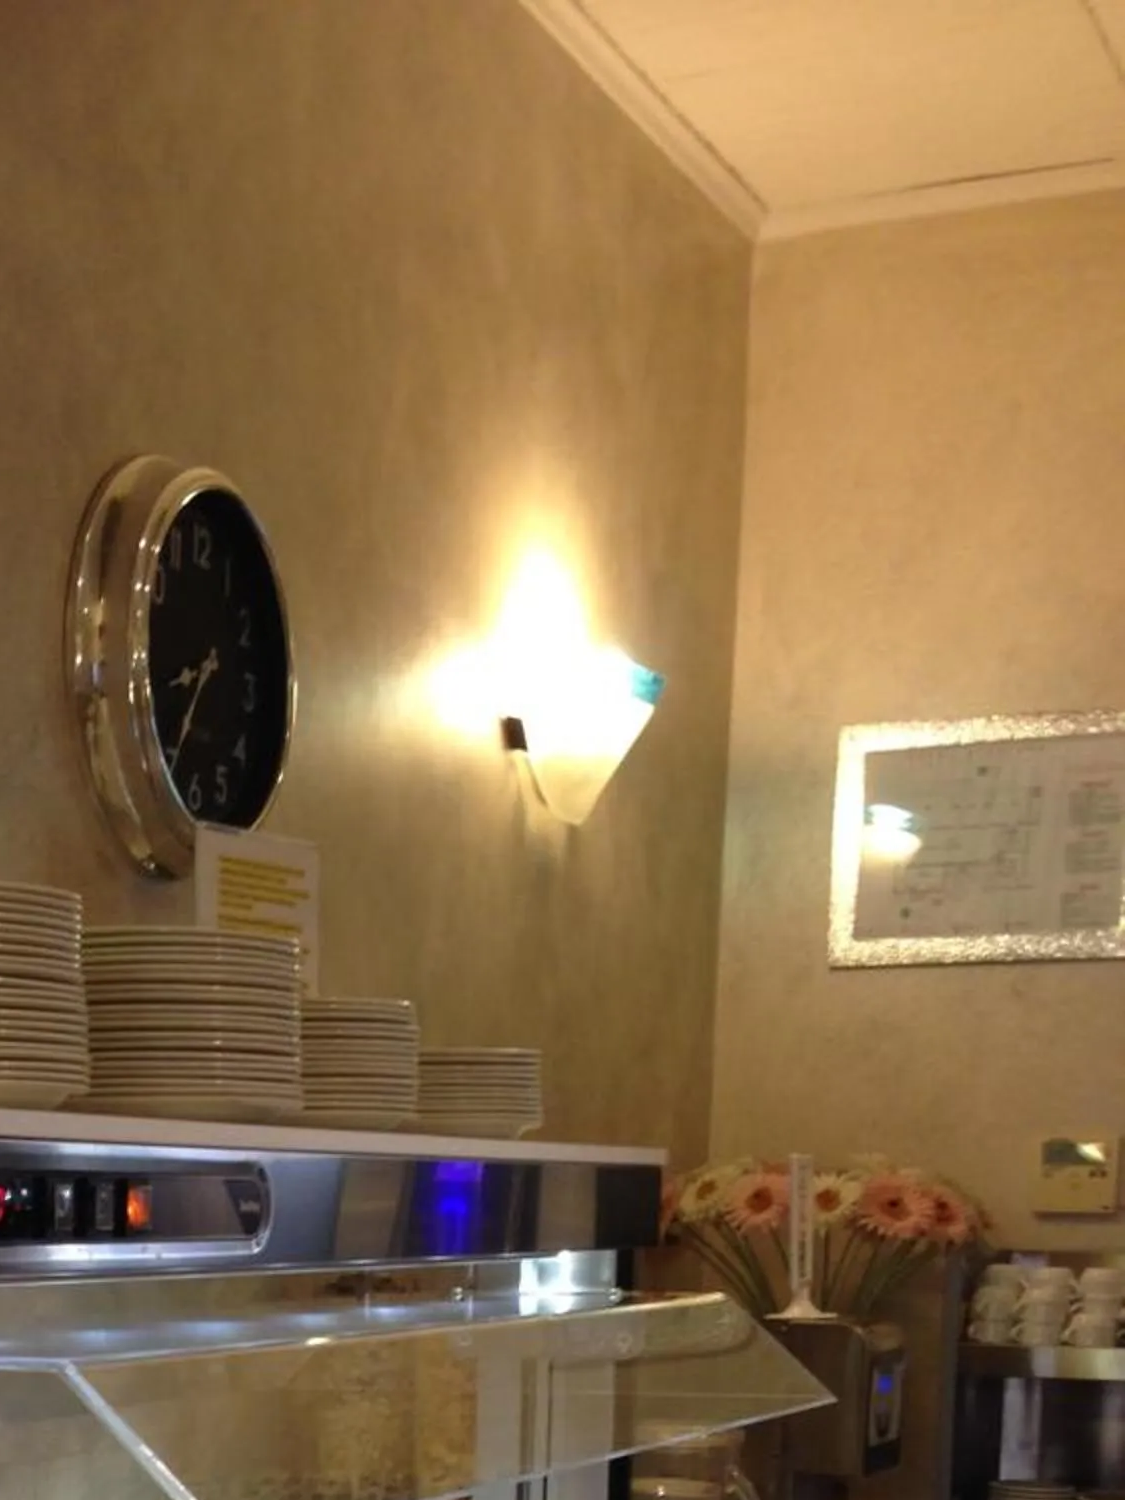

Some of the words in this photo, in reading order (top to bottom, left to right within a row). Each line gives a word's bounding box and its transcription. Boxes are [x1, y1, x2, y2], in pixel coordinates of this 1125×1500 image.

[191, 523, 211, 571] 12
[238, 608, 252, 647] 2
[242, 672, 257, 713] 3
[231, 733, 247, 770] 4
[188, 773, 202, 811] 6
[214, 766, 229, 804] 5
